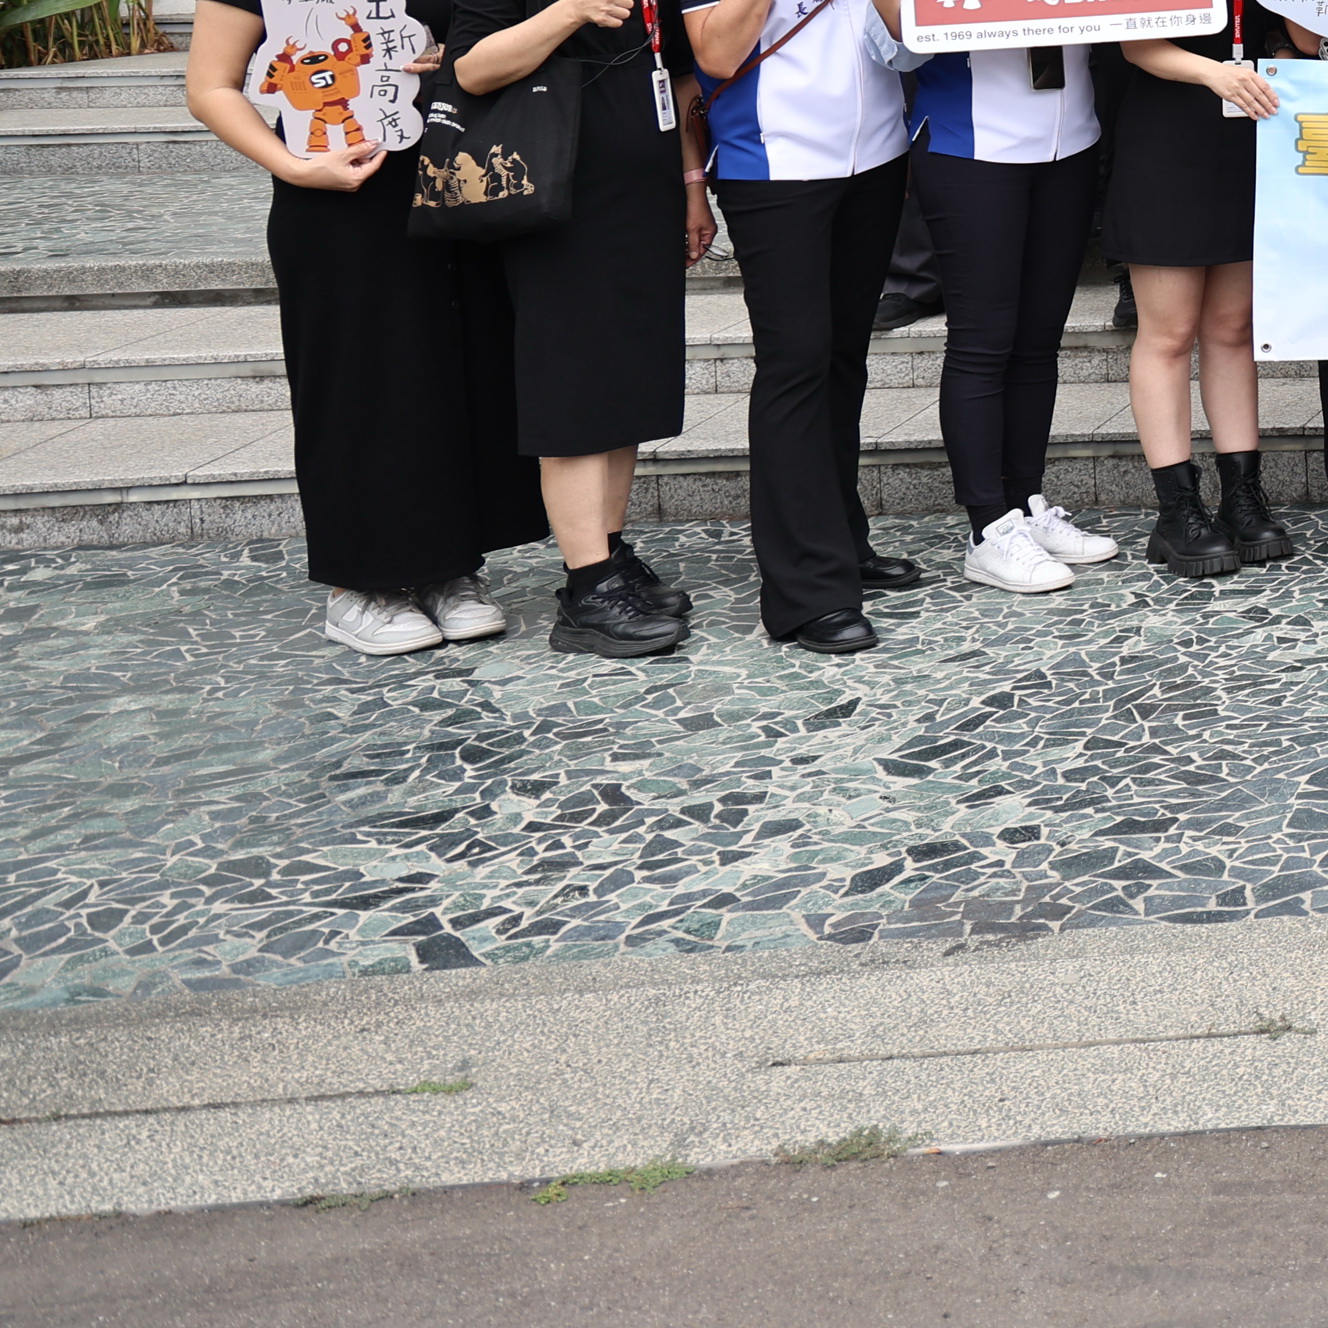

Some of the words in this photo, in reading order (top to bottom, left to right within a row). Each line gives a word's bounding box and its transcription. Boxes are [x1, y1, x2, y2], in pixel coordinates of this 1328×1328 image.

[916, 34, 940, 43] est.
[944, 30, 972, 41] 1969
[976, 27, 1018, 40] always
[1022, 25, 1054, 36] there
[1058, 23, 1076, 35] for
[1079, 24, 1101, 34] you
[1109, 12, 1213, 31] 一直就在你身邊
[310, 71, 335, 88] ST
